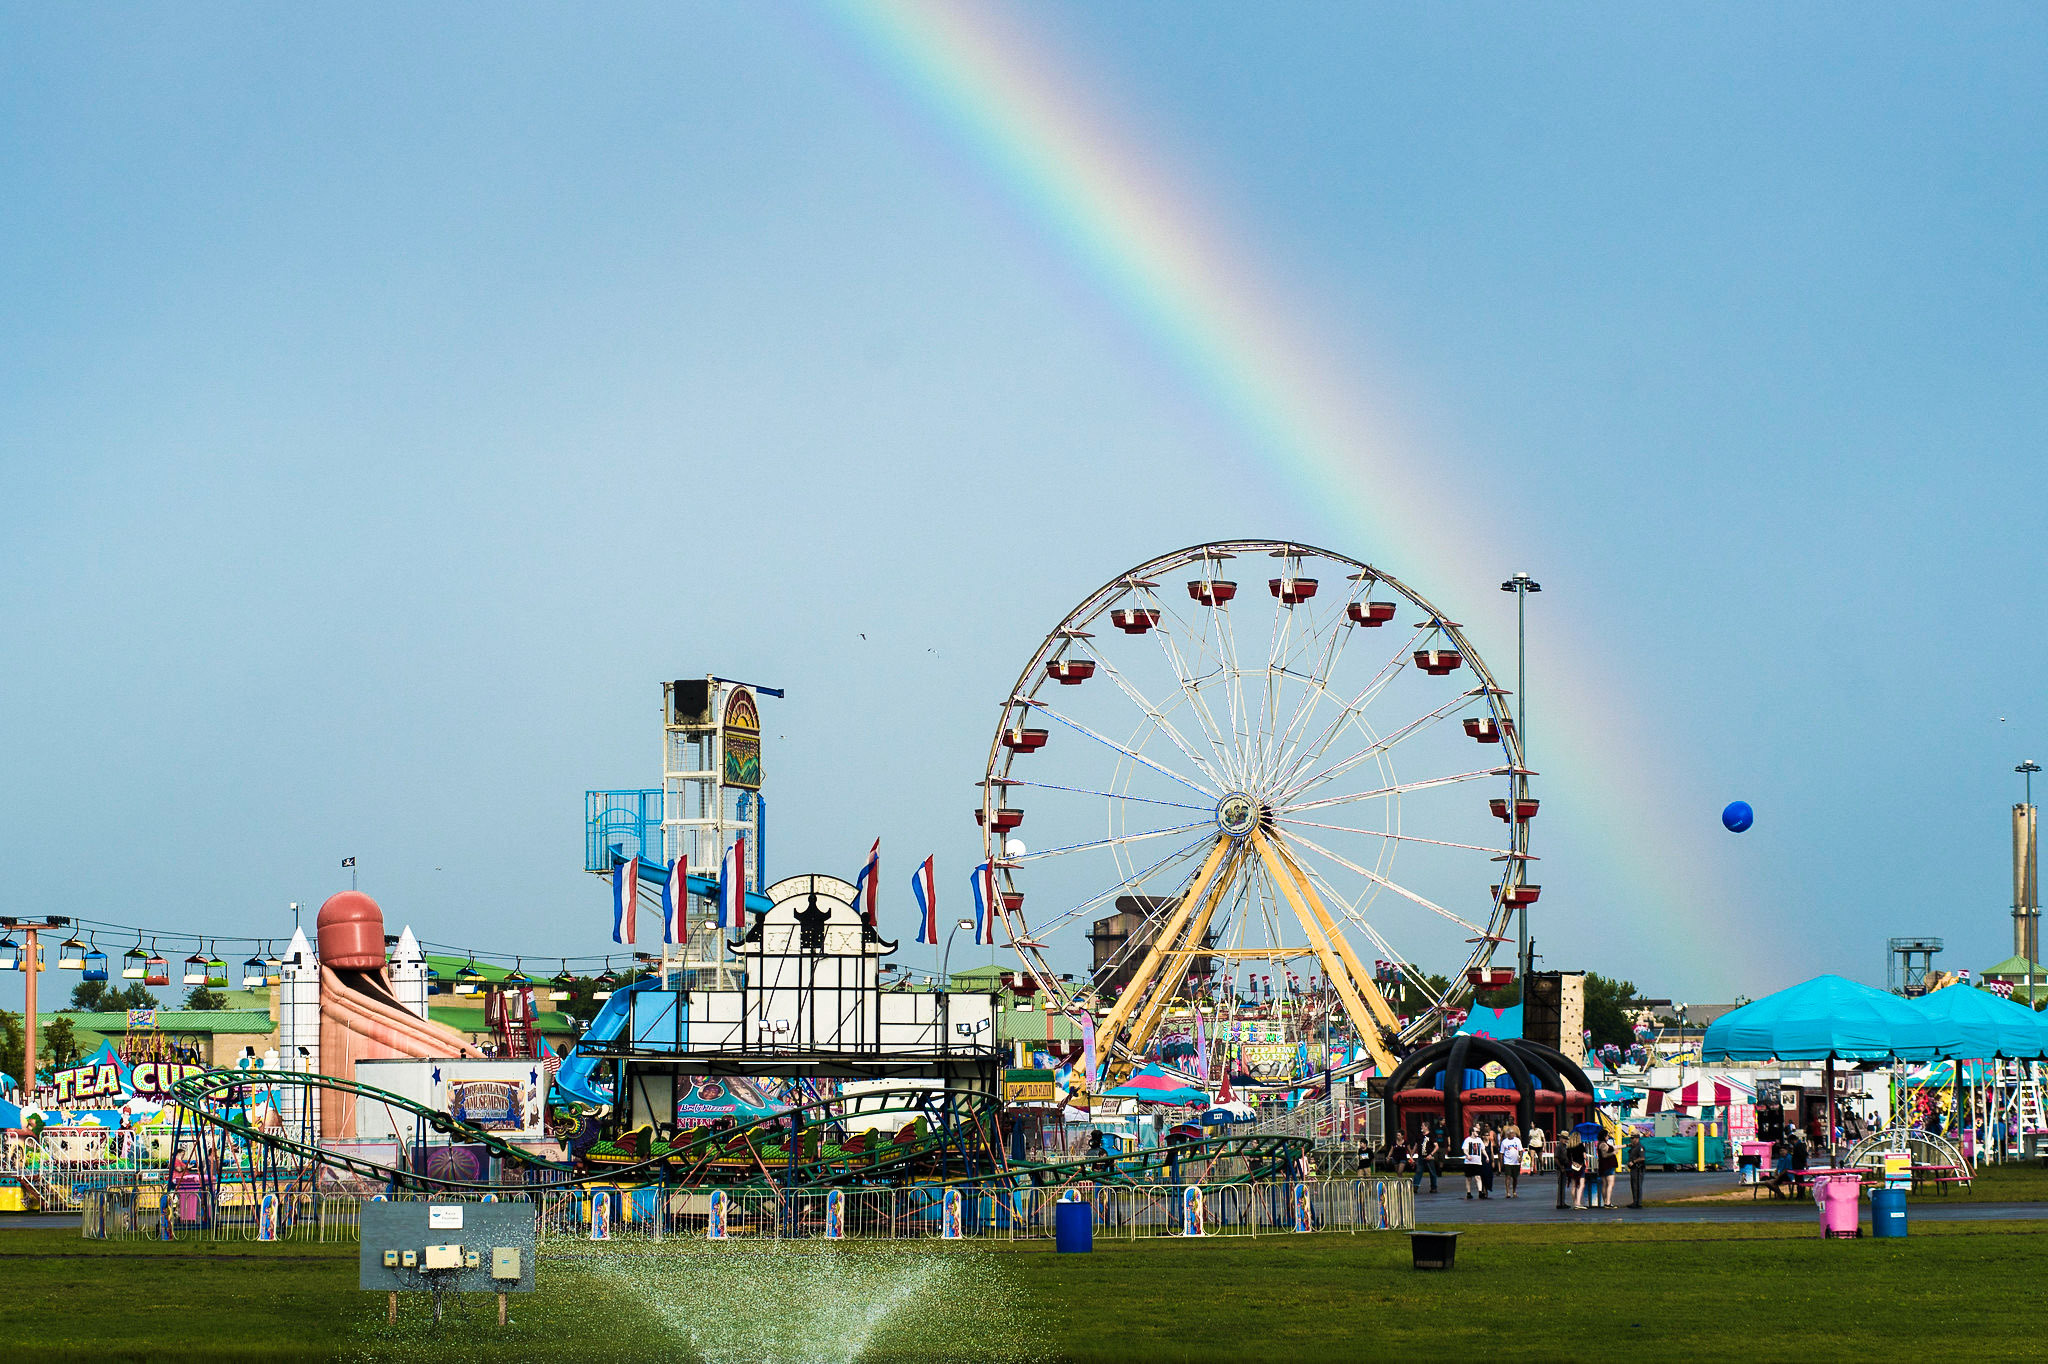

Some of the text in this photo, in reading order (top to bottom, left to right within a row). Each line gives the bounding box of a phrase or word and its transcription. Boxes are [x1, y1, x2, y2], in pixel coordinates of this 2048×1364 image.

[54, 1064, 121, 1102] TEA
[464, 1083, 508, 1098] DREAMLAND
[464, 1094, 509, 1111] AMUSEMENTS
[1469, 1093, 1511, 1103] SPORTS
